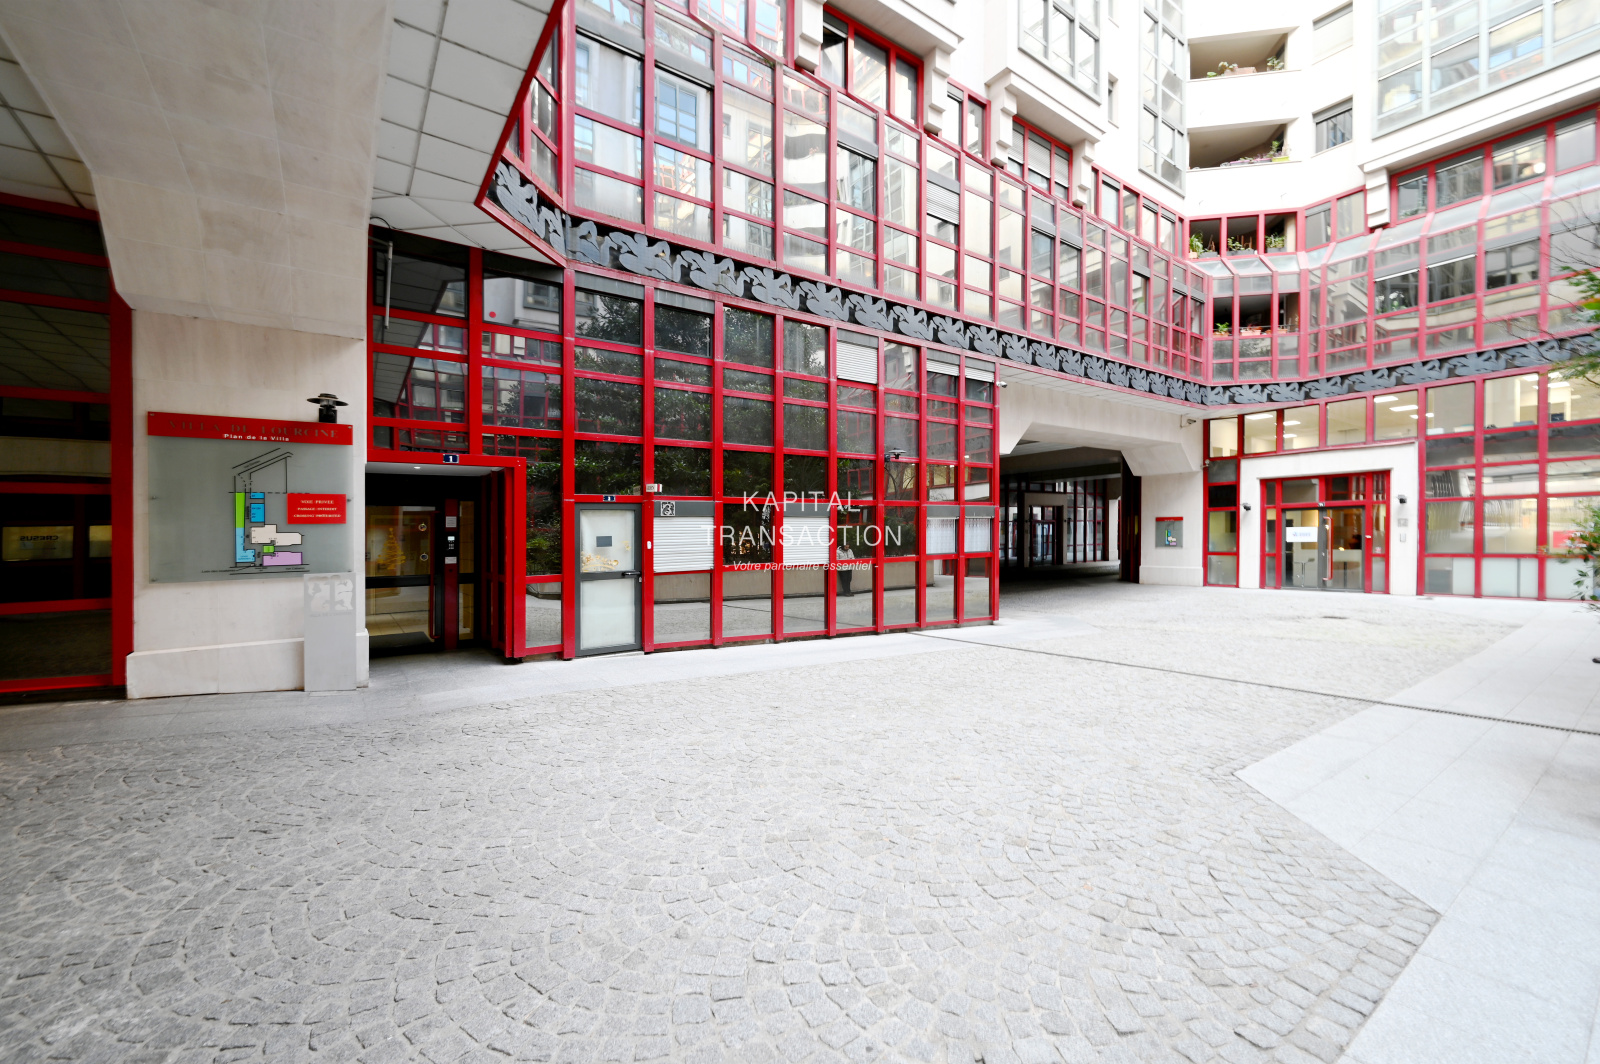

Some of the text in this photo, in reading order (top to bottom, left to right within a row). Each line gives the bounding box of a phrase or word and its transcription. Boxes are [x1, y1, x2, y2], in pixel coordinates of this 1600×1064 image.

[169, 420, 339, 439] VILLA DE LOURCINE
